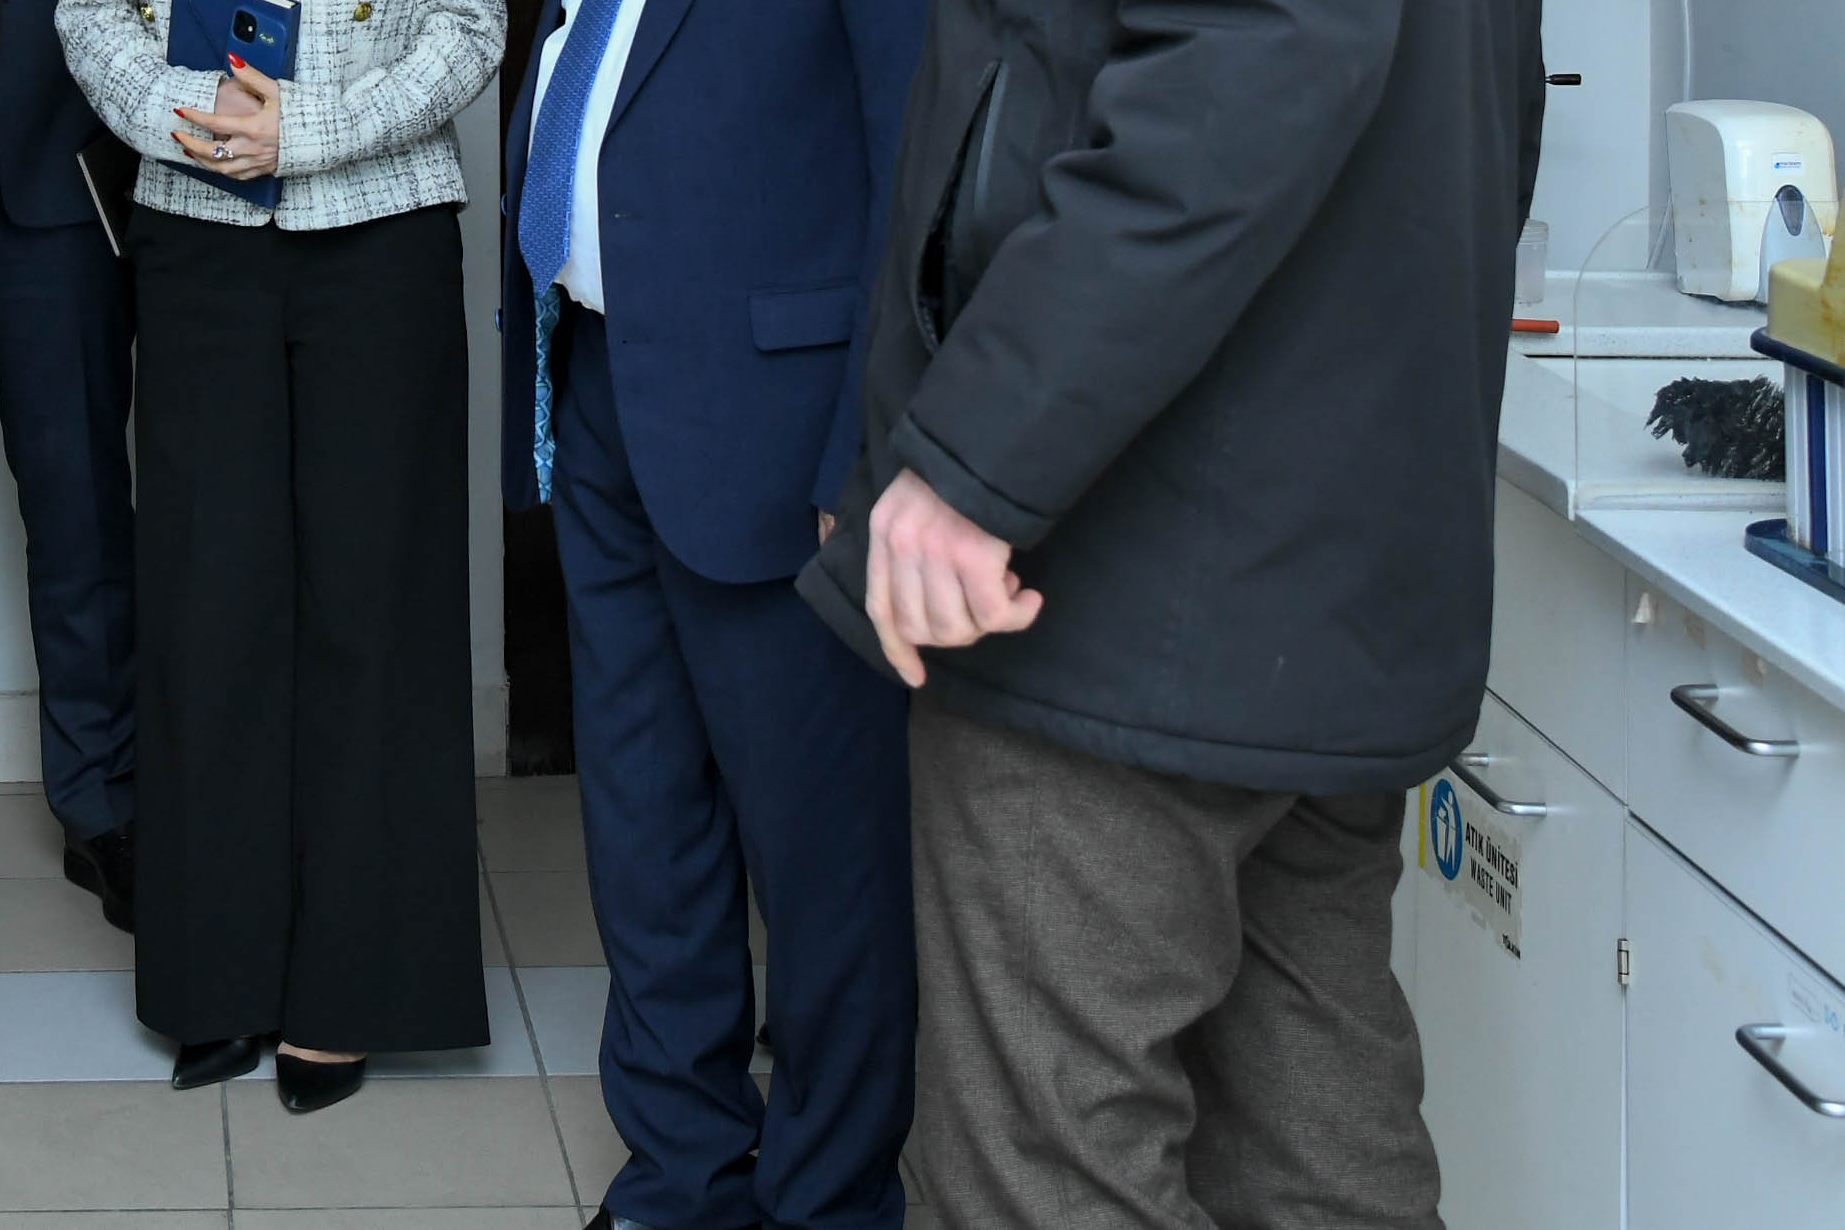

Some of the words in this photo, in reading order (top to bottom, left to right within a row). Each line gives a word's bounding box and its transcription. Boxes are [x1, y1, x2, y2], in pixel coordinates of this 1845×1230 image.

[1465, 822, 1484, 858] ATIK
[1470, 857, 1494, 898] WASTE
[1495, 879, 1512, 915] UNIT
